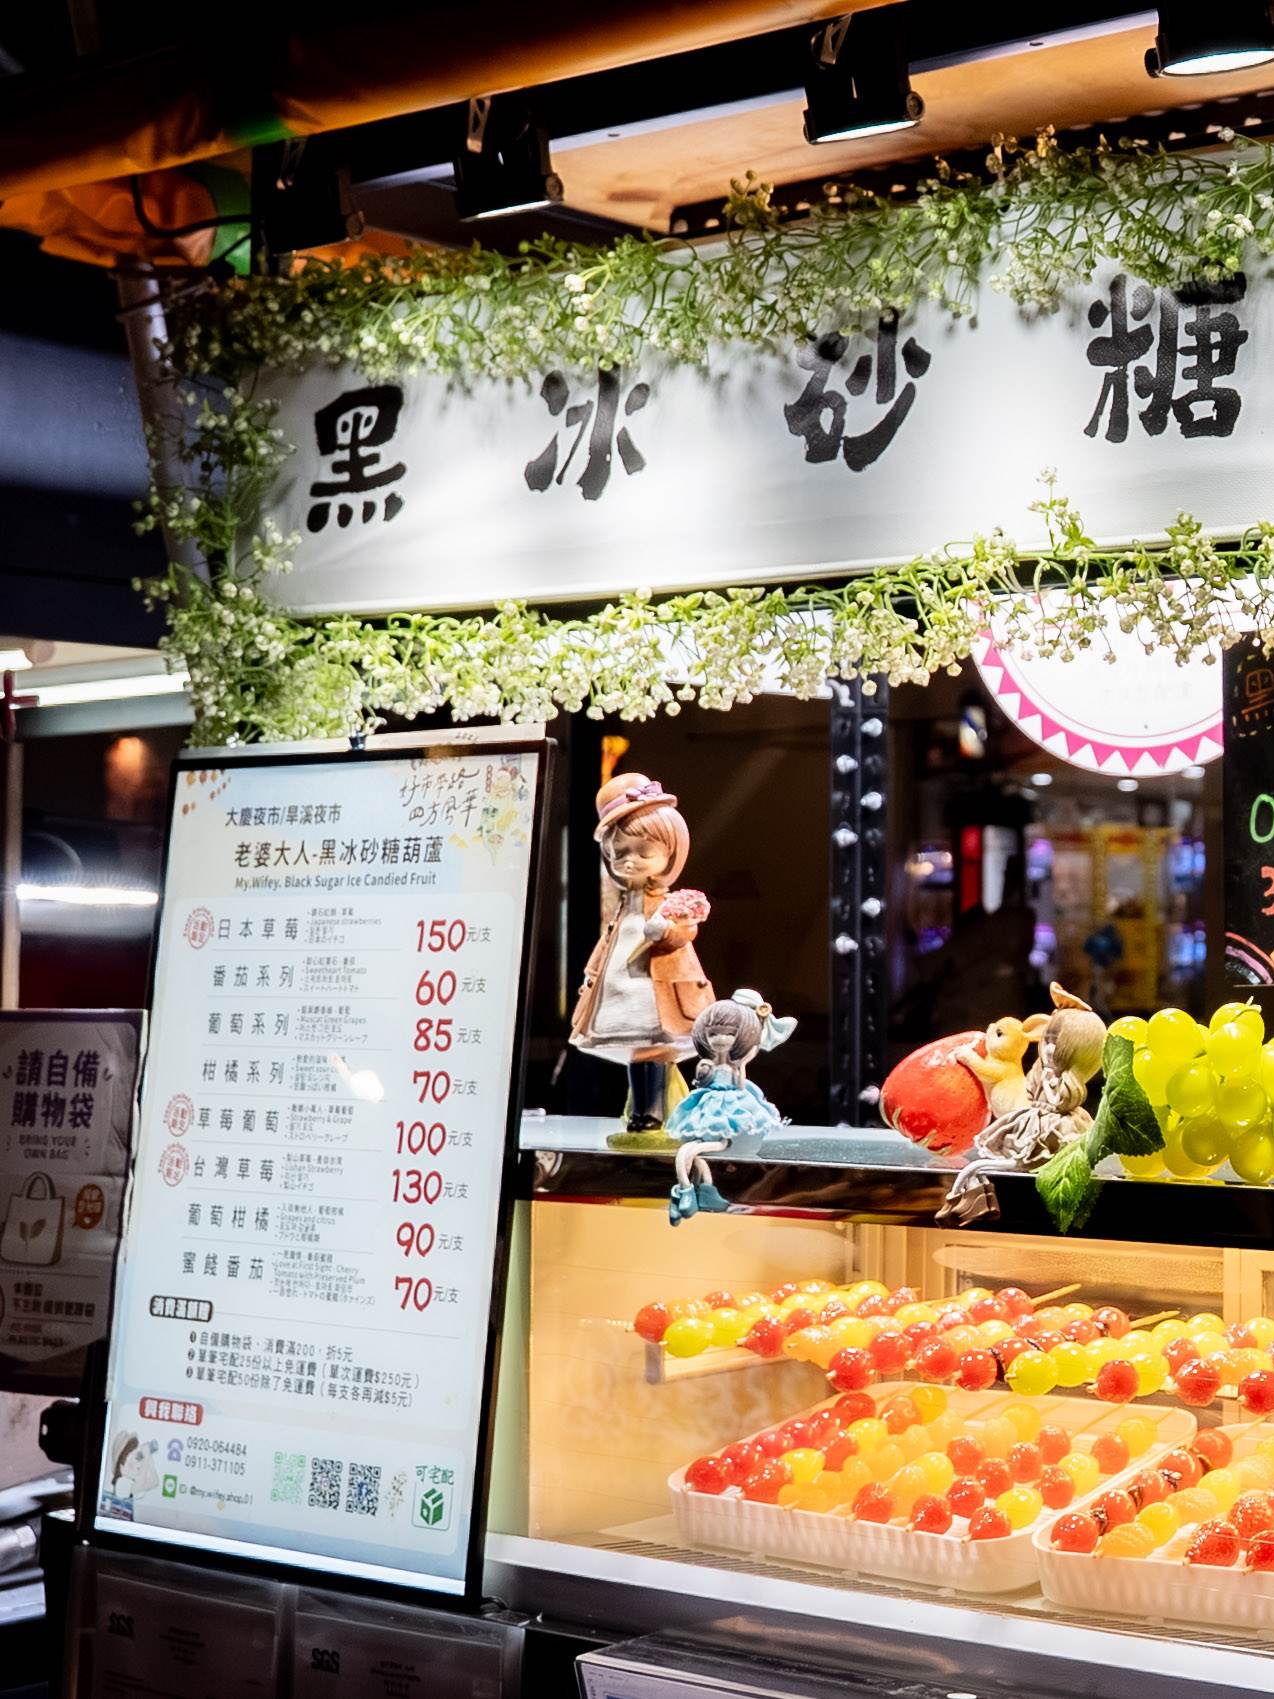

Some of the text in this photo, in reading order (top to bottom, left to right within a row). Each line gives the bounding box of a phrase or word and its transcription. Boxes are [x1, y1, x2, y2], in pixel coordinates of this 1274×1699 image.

[225, 804, 341, 827] 大慶夜市/旱溪夜市
[234, 835, 444, 868] 老婆大人-黑冰砂糖葫蘆
[285, 875, 312, 888] Black
[314, 874, 343, 890] Sugar
[347, 875, 361, 887] Ice
[363, 872, 408, 887] Candied
[410, 871, 437, 886] Fruit
[218, 918, 299, 941] 日本草莓
[416, 918, 467, 953] 150
[467, 926, 492, 943] 元/支
[213, 965, 487, 1007] 番茄系列 60 元/支
[208, 1012, 482, 1052] 葡萄系列 85 元/支
[16, 1049, 99, 1088] 請自備
[202, 1059, 478, 1104] 柑橘系列 70 元/支
[10, 1091, 94, 1128] 購物袋
[197, 1107, 279, 1133] 草莓葡萄
[395, 1120, 446, 1156] 100
[447, 1130, 473, 1148] 元/支
[193, 1155, 274, 1182] 台灣草莓
[392, 1169, 443, 1205] 130
[443, 1181, 468, 1199] 元/支
[188, 1203, 269, 1232] 葡萄柑橘
[396, 1222, 435, 1257] 90
[438, 1233, 464, 1252] 元/支
[182, 1250, 264, 1280] 蜜餞番茄
[394, 1276, 434, 1312] 70
[433, 1285, 459, 1303] 元/支
[415, 1465, 455, 1486] 可宅配
[311, 1647, 340, 1674] SGS
